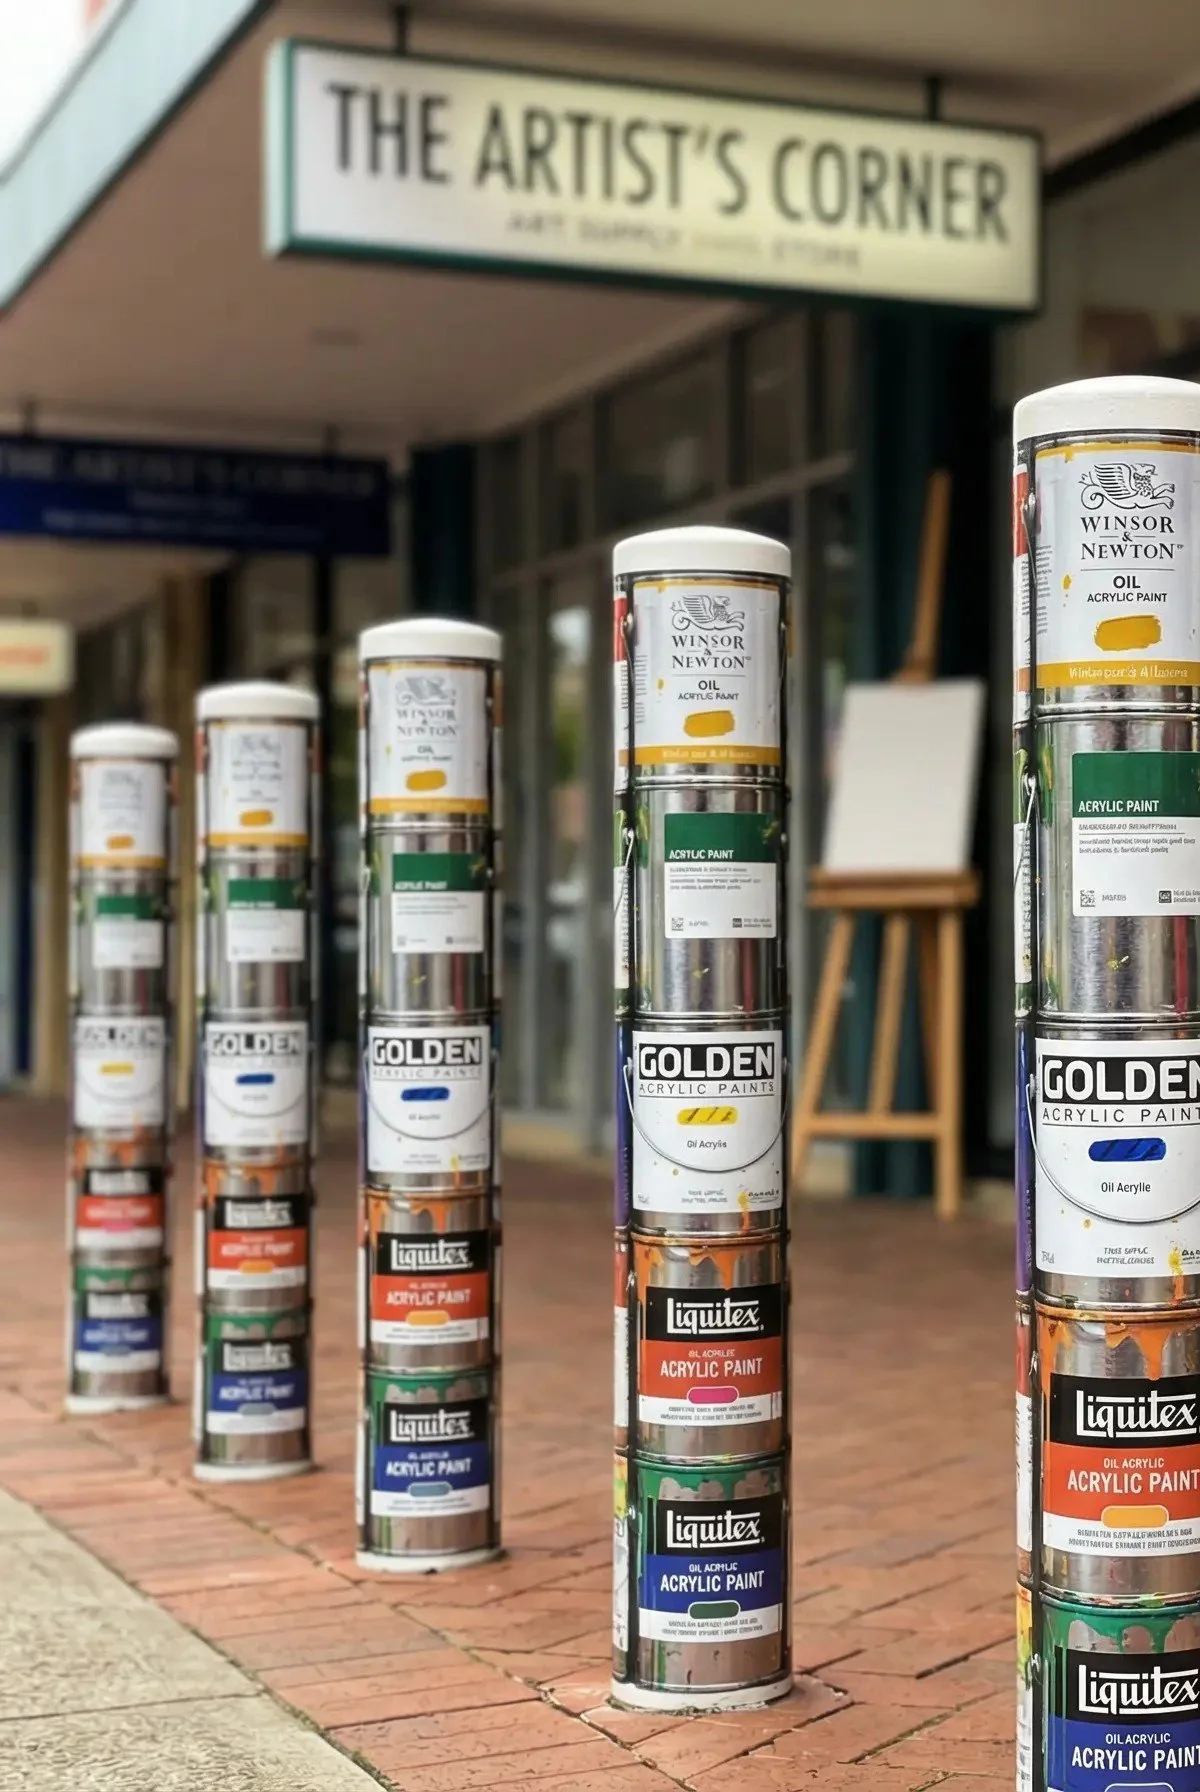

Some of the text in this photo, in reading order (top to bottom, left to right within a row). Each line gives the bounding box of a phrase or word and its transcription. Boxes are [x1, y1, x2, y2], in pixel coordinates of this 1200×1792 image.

[325, 79, 1012, 242] THE ARTIST'S CORNER
[1081, 516, 1175, 534] WINSOR
[1122, 532, 1133, 542] &
[1081, 543, 1175, 560] NEWTON
[1113, 575, 1141, 589] OIL
[1087, 593, 1168, 603] ACRYLIC PAINT
[672, 635, 745, 651] WINSOR
[672, 655, 745, 669] NEWTON
[698, 680, 720, 691] OIL
[1126, 800, 1160, 813] PAINT
[707, 849, 735, 860] PAINT
[373, 1038, 481, 1066] GOLDEN
[640, 1045, 773, 1078] GOLDEN
[639, 1081, 775, 1095] ACRYLIC PAINTS
[1042, 1107, 1125, 1123] ACRYLIC
[1101, 1182, 1115, 1193] Oil
[390, 1238, 470, 1271] Liquitex
[385, 1288, 471, 1306] ACRYLIC PAINT
[667, 1297, 760, 1335] Liquitex
[660, 1357, 763, 1378] ACRYLIC PAINT
[1076, 1390, 1198, 1438] Liquitex
[390, 1408, 471, 1442] Liquitex
[385, 1457, 472, 1477] ACRYLIC PAINT
[1103, 1457, 1165, 1469] OIL ACRYLIC
[1067, 1468, 1200, 1494] ACRYLIC PAINT
[667, 1510, 761, 1548] Liquitex
[660, 1570, 765, 1593] ACRYLIC PAINT
[1078, 1664, 1200, 1715] Liquitex
[1105, 1732, 1171, 1745] OIL ACRYLIC
[1071, 1746, 1147, 1771] ACRYLIC
